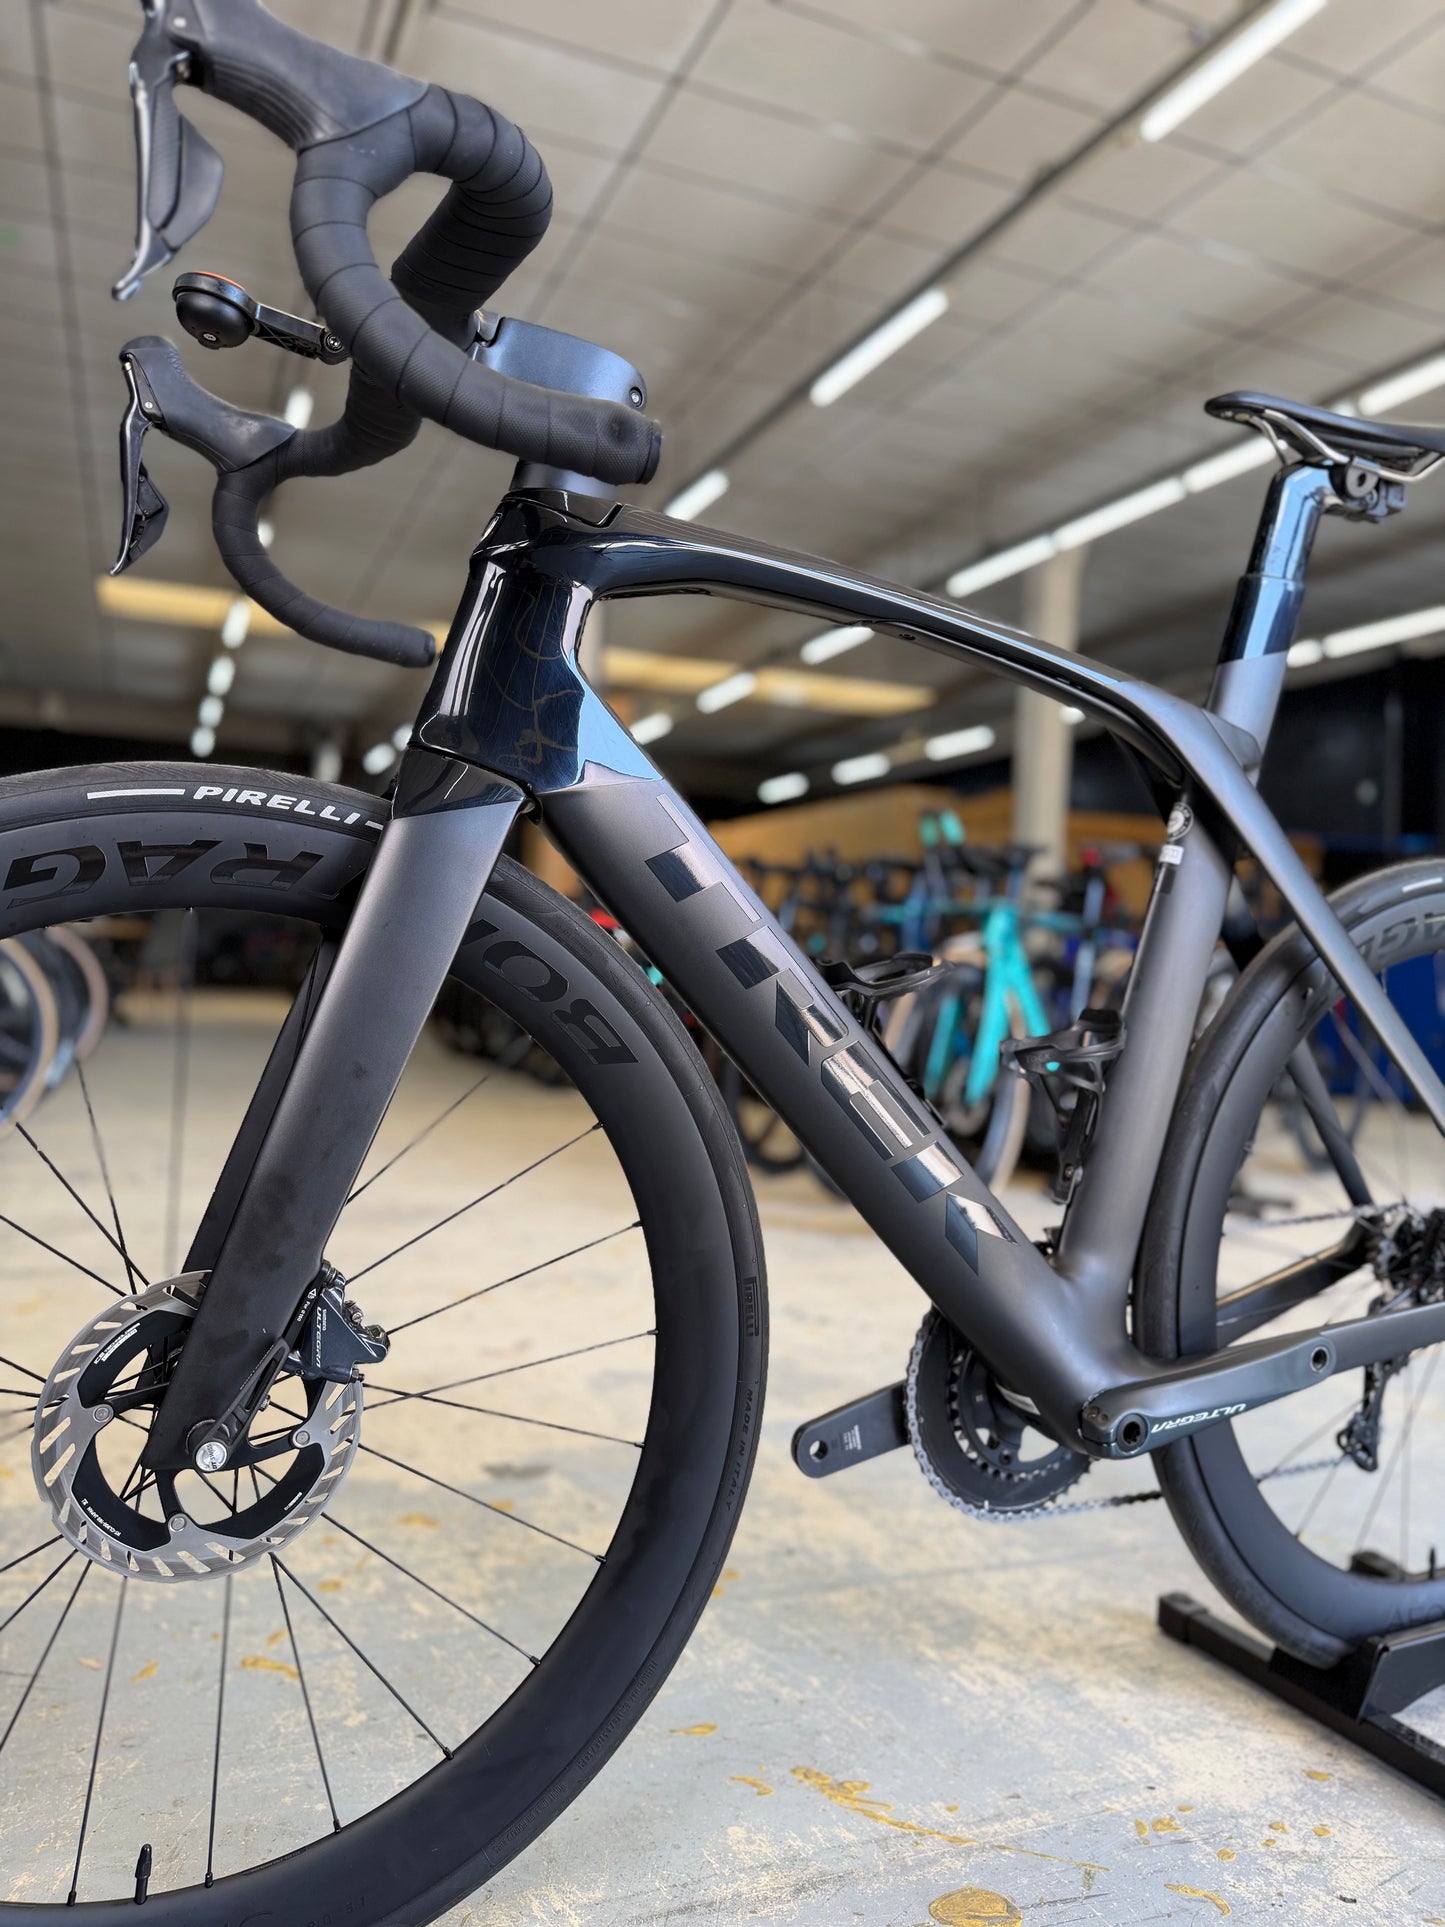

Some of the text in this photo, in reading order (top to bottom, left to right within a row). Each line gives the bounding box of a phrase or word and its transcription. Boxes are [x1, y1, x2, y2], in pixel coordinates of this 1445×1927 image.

[193, 786, 361, 826] PIRELLI
[645, 794, 1017, 1275] TREK
[727, 1388, 753, 1512] MADE IN ITALY
[1150, 1402, 1247, 1434] ULTEGRA
